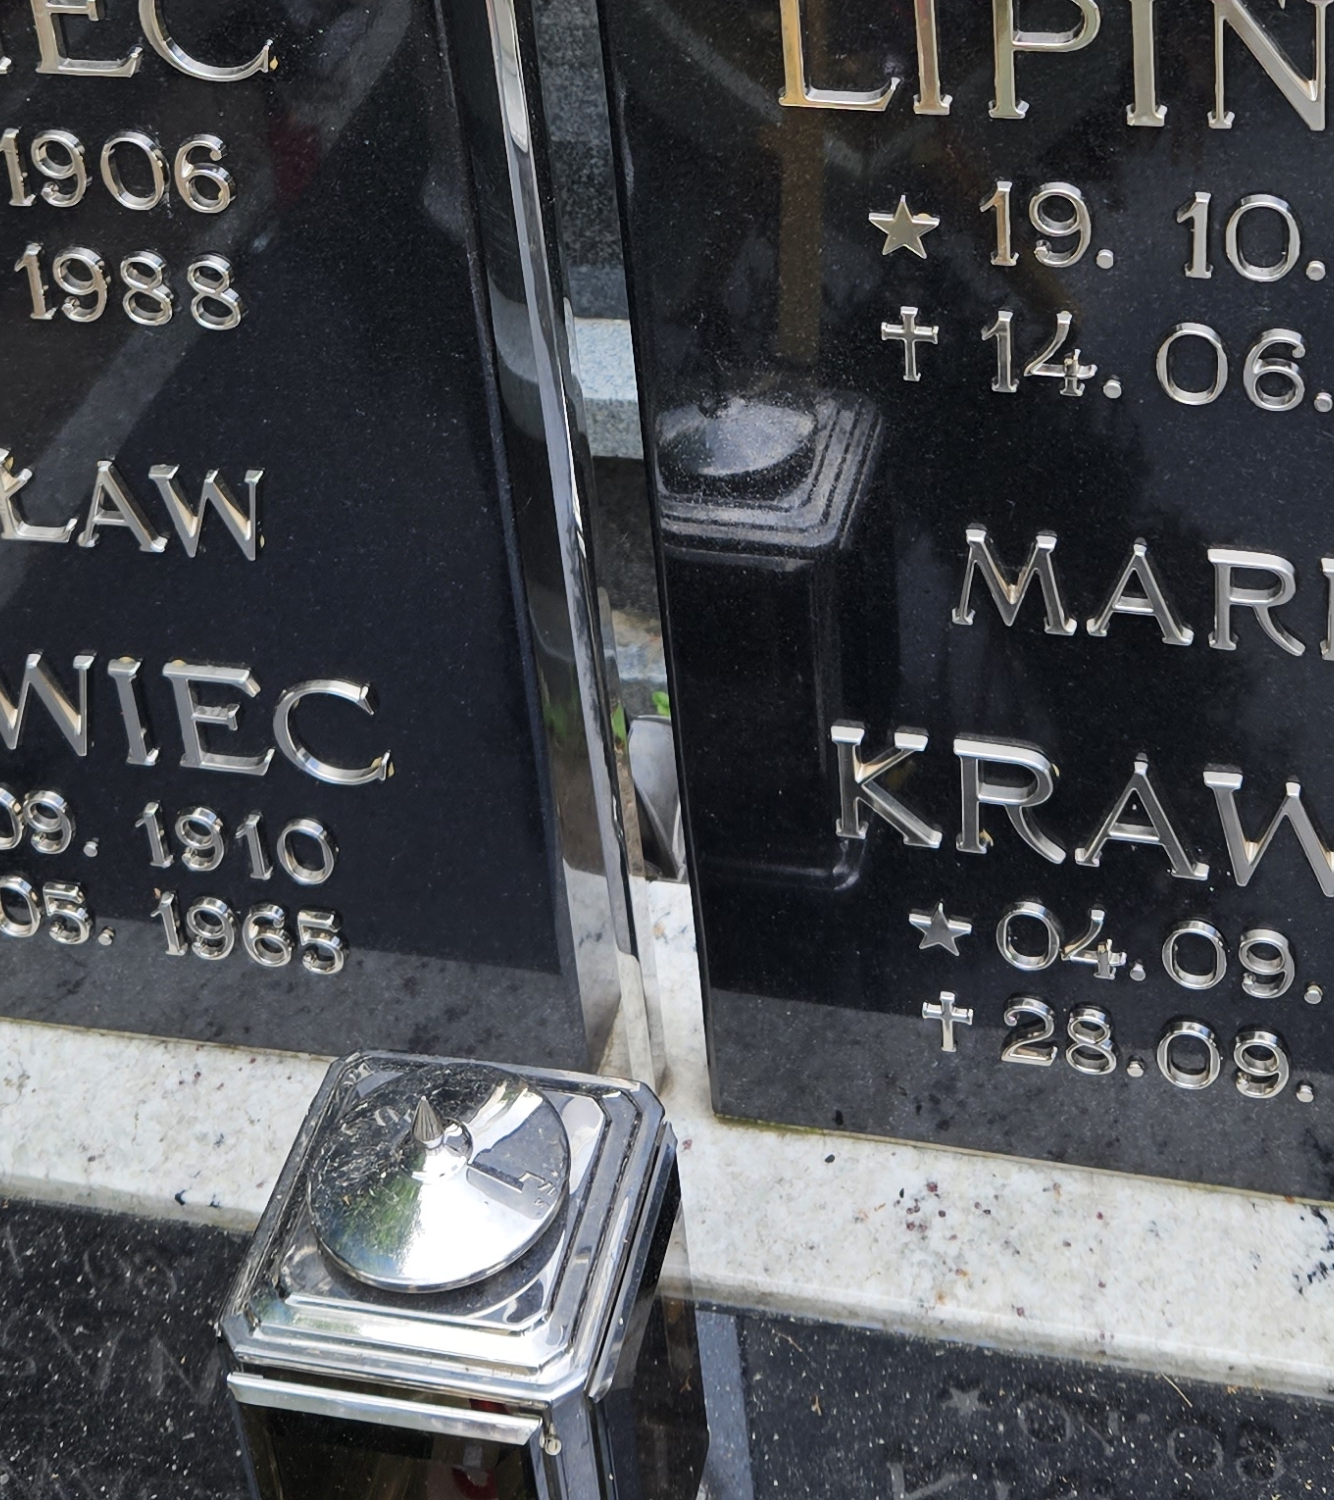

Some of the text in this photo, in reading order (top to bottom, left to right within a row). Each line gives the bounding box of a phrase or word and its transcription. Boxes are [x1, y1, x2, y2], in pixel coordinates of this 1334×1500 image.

[980, 181, 1114, 268] 19.
[1177, 191, 1325, 281] 10.
[15, 241, 242, 330] 1988
[135, 802, 336, 885] 1910
[154, 889, 346, 975] 1965
